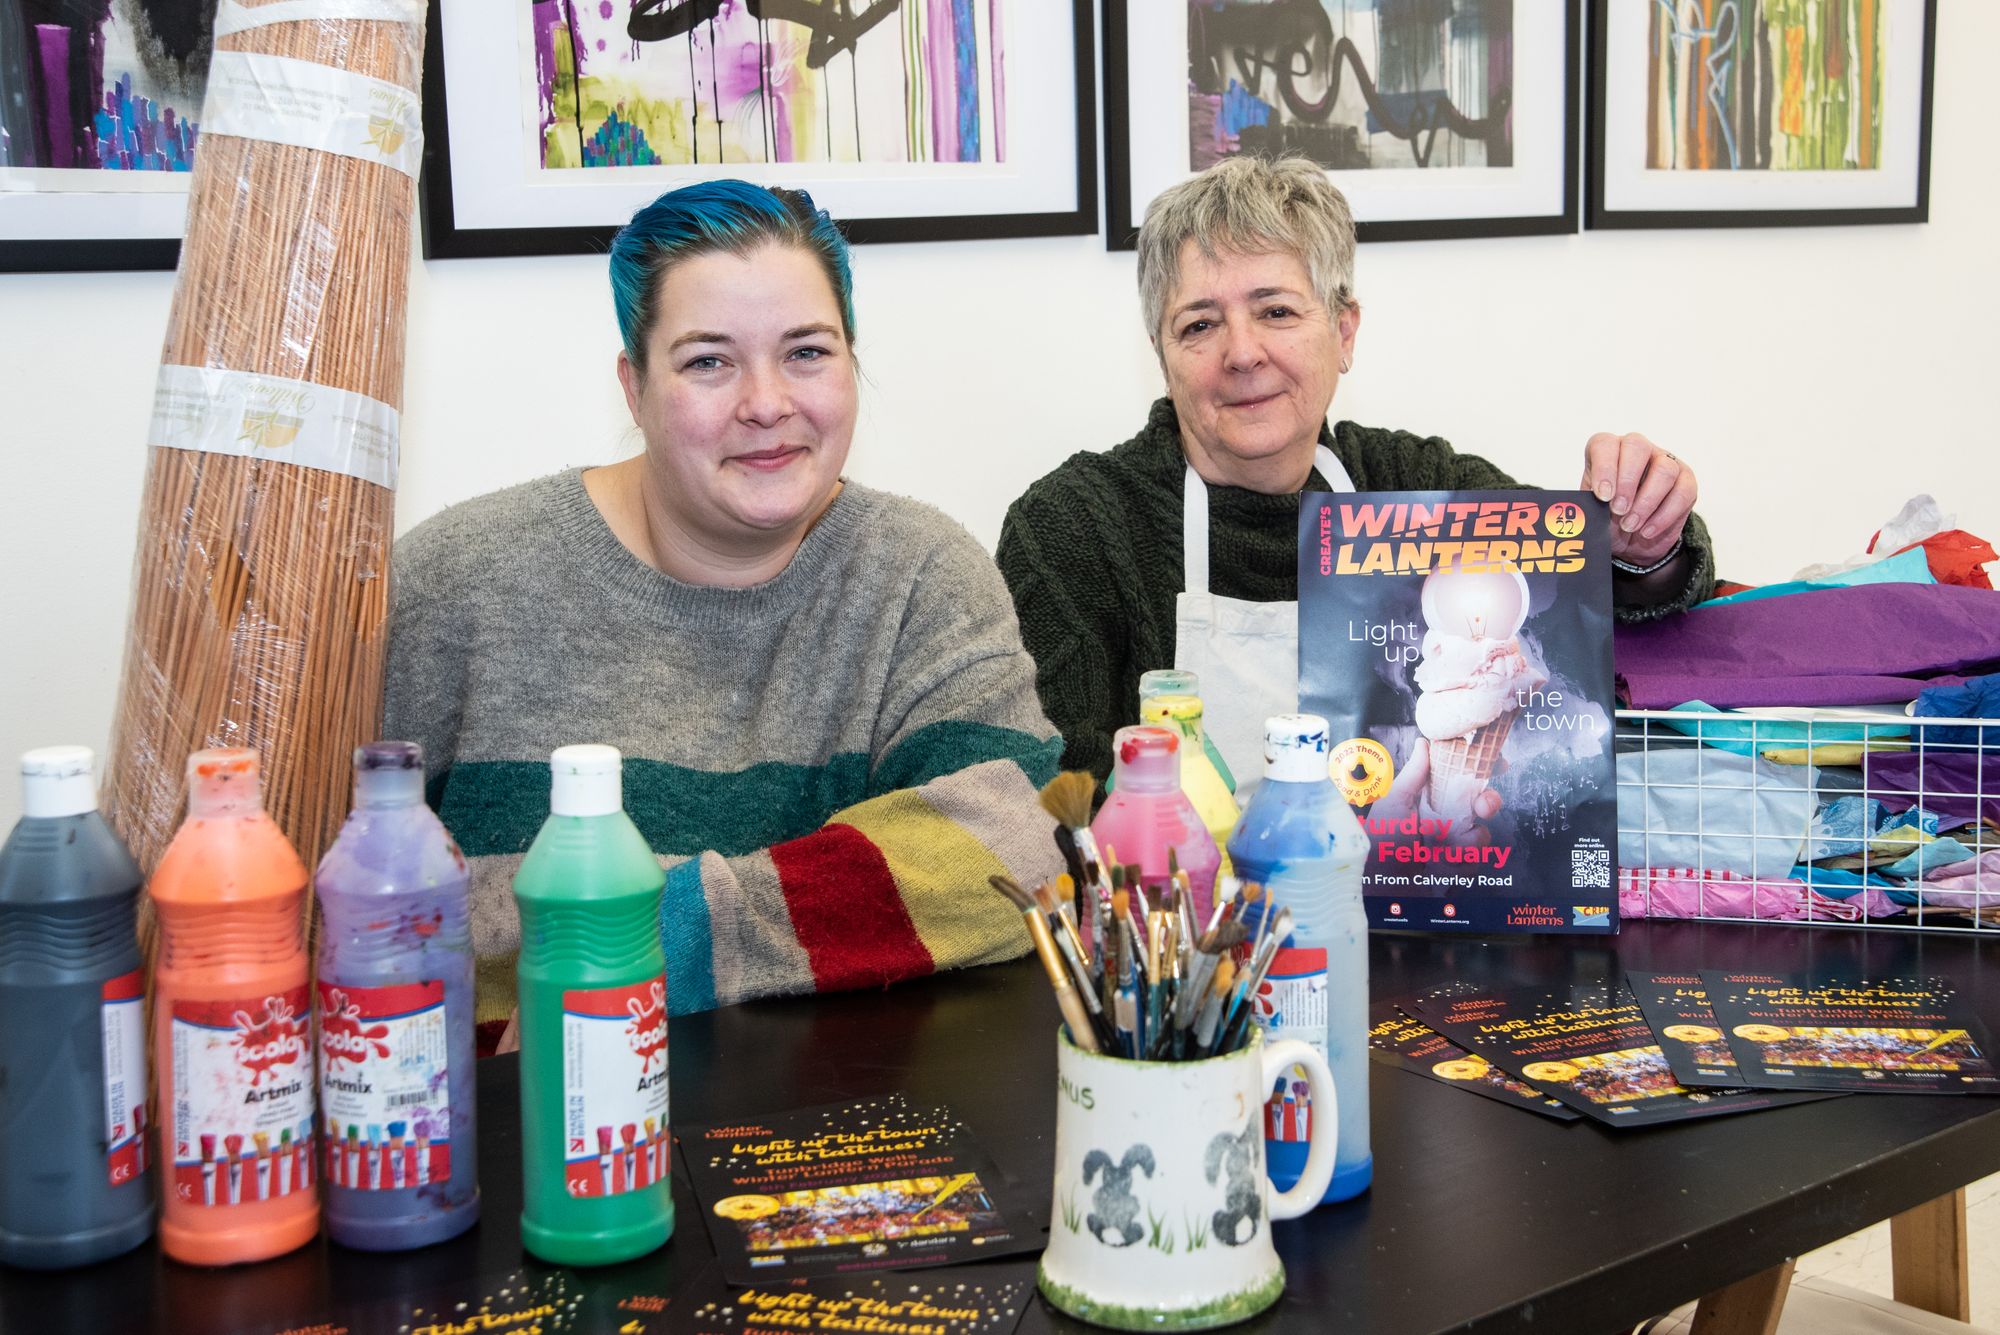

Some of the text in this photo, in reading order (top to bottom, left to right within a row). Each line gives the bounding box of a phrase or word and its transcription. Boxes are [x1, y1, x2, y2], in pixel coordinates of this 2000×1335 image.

[1339, 502, 1541, 538] WINTER
[1319, 505, 1331, 576] CREATE'S
[1335, 540, 1586, 576] LANTERNS
[1348, 620, 1418, 647] Light
[1384, 645, 1420, 667] up
[1516, 685, 1563, 708] the
[1524, 711, 1595, 731] town
[1355, 745, 1384, 764] Theme
[1363, 776, 1383, 796] Drink
[1356, 812, 1453, 840] turday
[1378, 840, 1511, 869] February
[1374, 874, 1409, 886] From
[1413, 874, 1474, 888] Calverley
[1478, 875, 1513, 886] Road
[1507, 914, 1564, 926] Lanterns
[1675, 988, 1706, 999] Lig
[1747, 987, 1932, 998] Light up the town
[1769, 997, 1818, 1006] with
[1367, 1020, 1404, 1038] ight
[1479, 1003, 1640, 1033] Light up the town
[1512, 1026, 1559, 1040] with
[244, 1079, 302, 1104] Artmix
[325, 1071, 373, 1094] Artmix
[577, 1096, 585, 1136] BRITAIN
[732, 1126, 938, 1156] Light up the town
[756, 1140, 926, 1166] with tastiness
[765, 1152, 918, 1176] Tunbridge Wells
[733, 1173, 795, 1185] Winter
[738, 1289, 979, 1320] Light up the town
[747, 1309, 812, 1328] with
